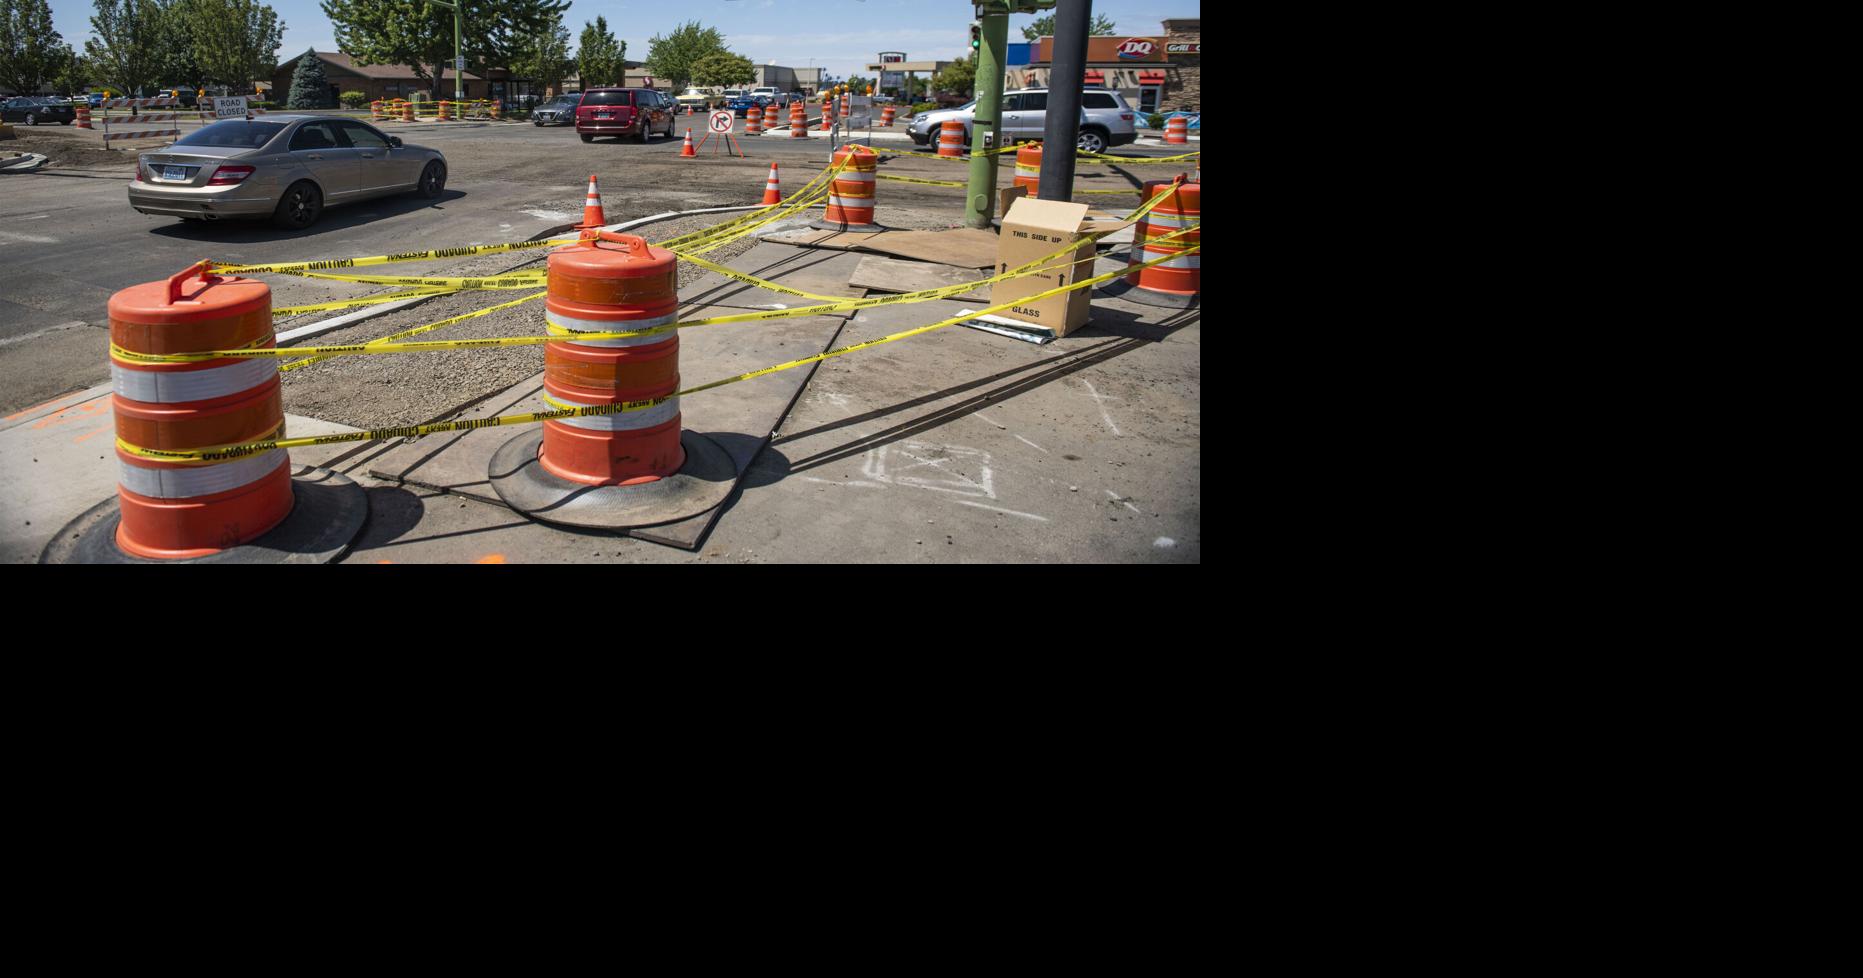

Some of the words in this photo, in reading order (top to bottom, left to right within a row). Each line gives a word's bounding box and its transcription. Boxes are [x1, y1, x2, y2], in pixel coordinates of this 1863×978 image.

[1124, 42, 1152, 54] DQ
[1168, 44, 1189, 52] Grill
[220, 99, 240, 107] ROAD
[217, 108, 246, 116] CLOSED
[309, 258, 353, 270] CAUTION
[1012, 306, 1040, 317] GLASS
[533, 408, 576, 420] FASTENAL
[581, 402, 623, 416] CUIDADO
[455, 417, 500, 431] CAUTION
